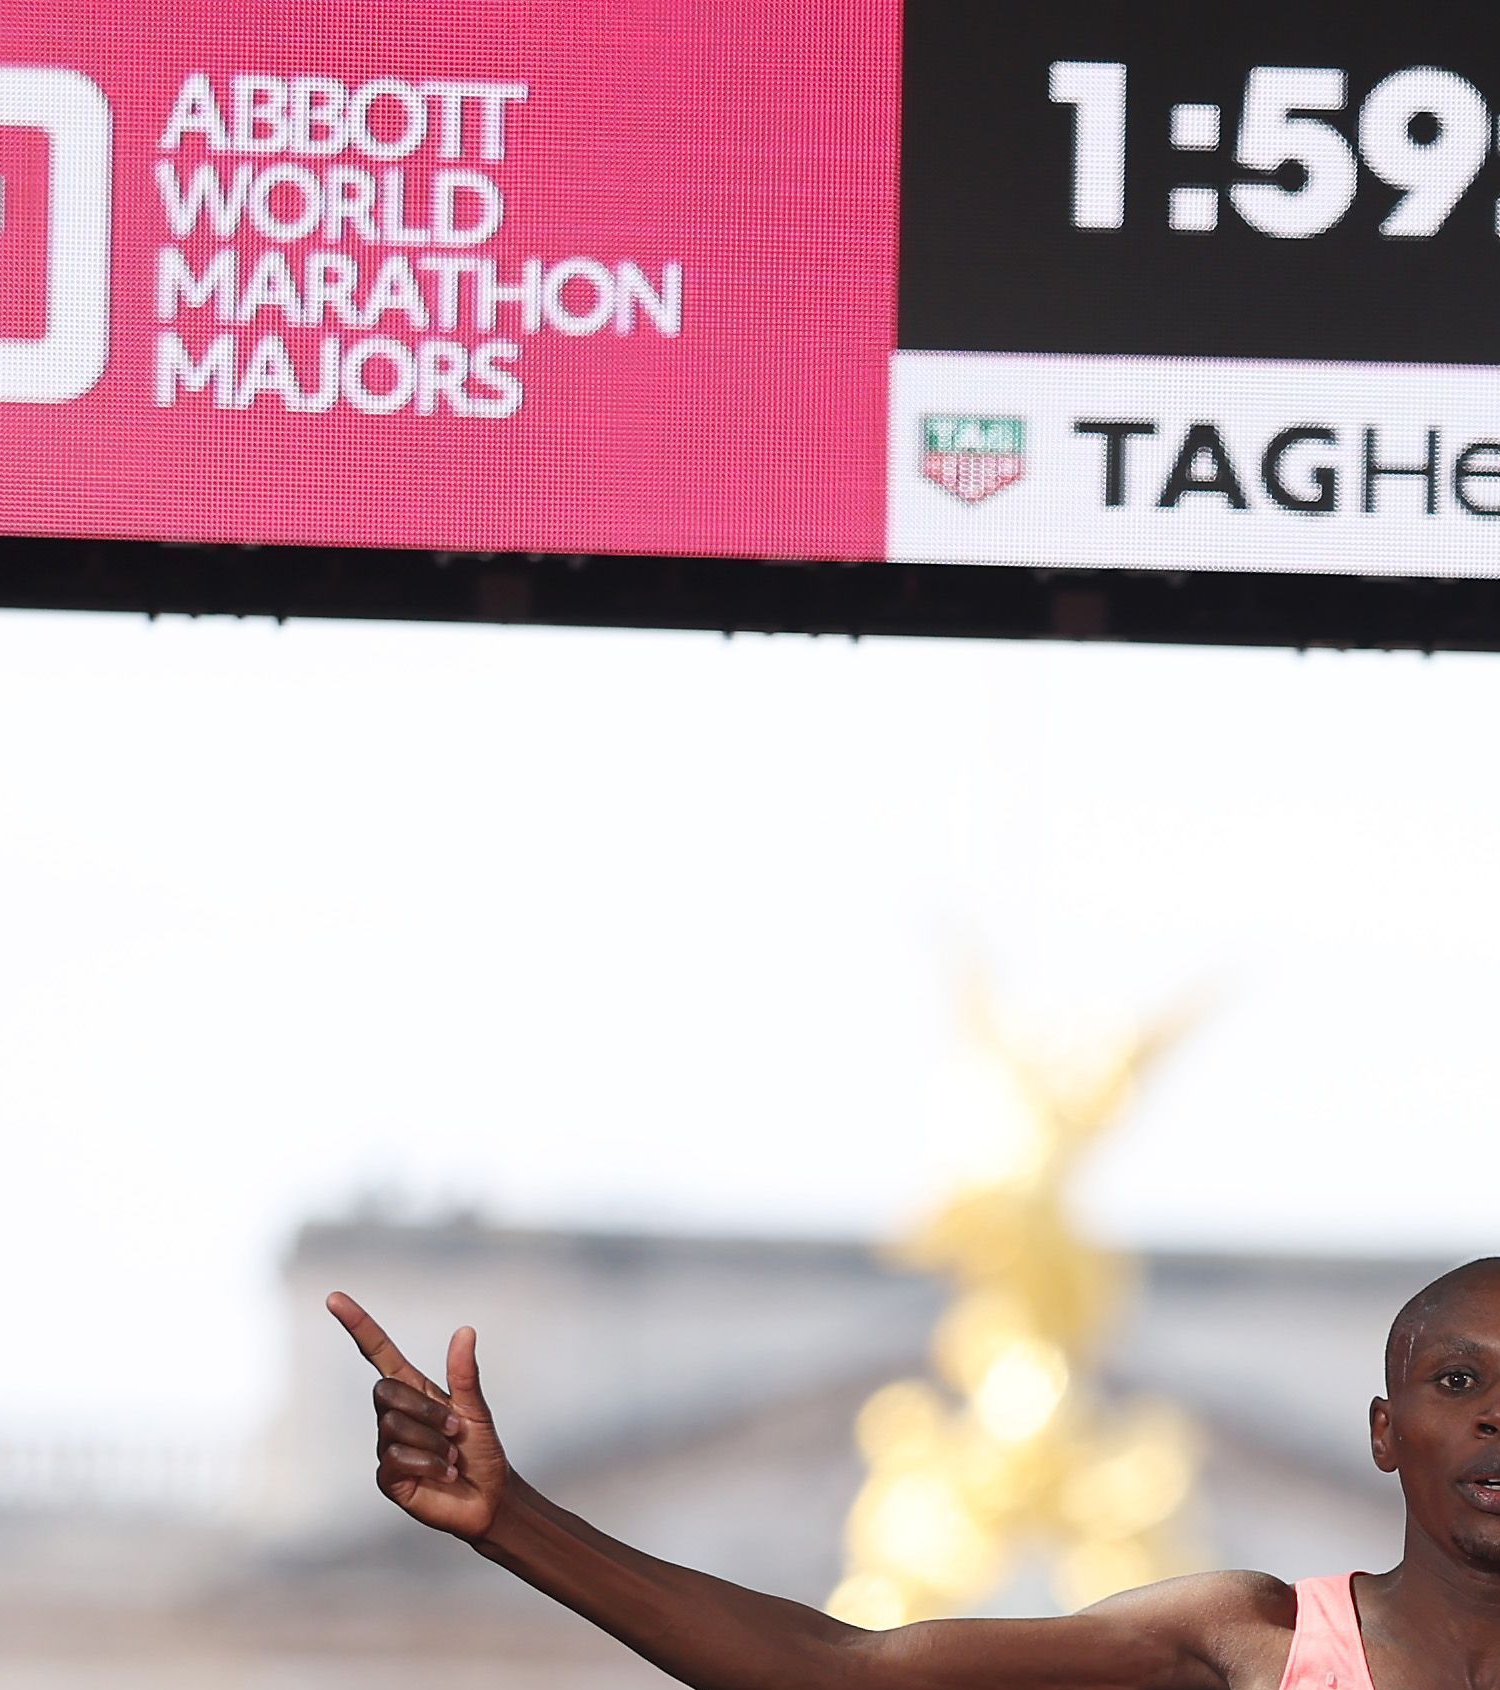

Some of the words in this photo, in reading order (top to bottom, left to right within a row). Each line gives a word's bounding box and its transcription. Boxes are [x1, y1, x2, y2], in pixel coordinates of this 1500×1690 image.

[158, 74, 529, 160] ABBOTT
[155, 162, 503, 246] WORLD
[156, 248, 683, 336] MARATHON
[155, 333, 525, 419] MAJORS
